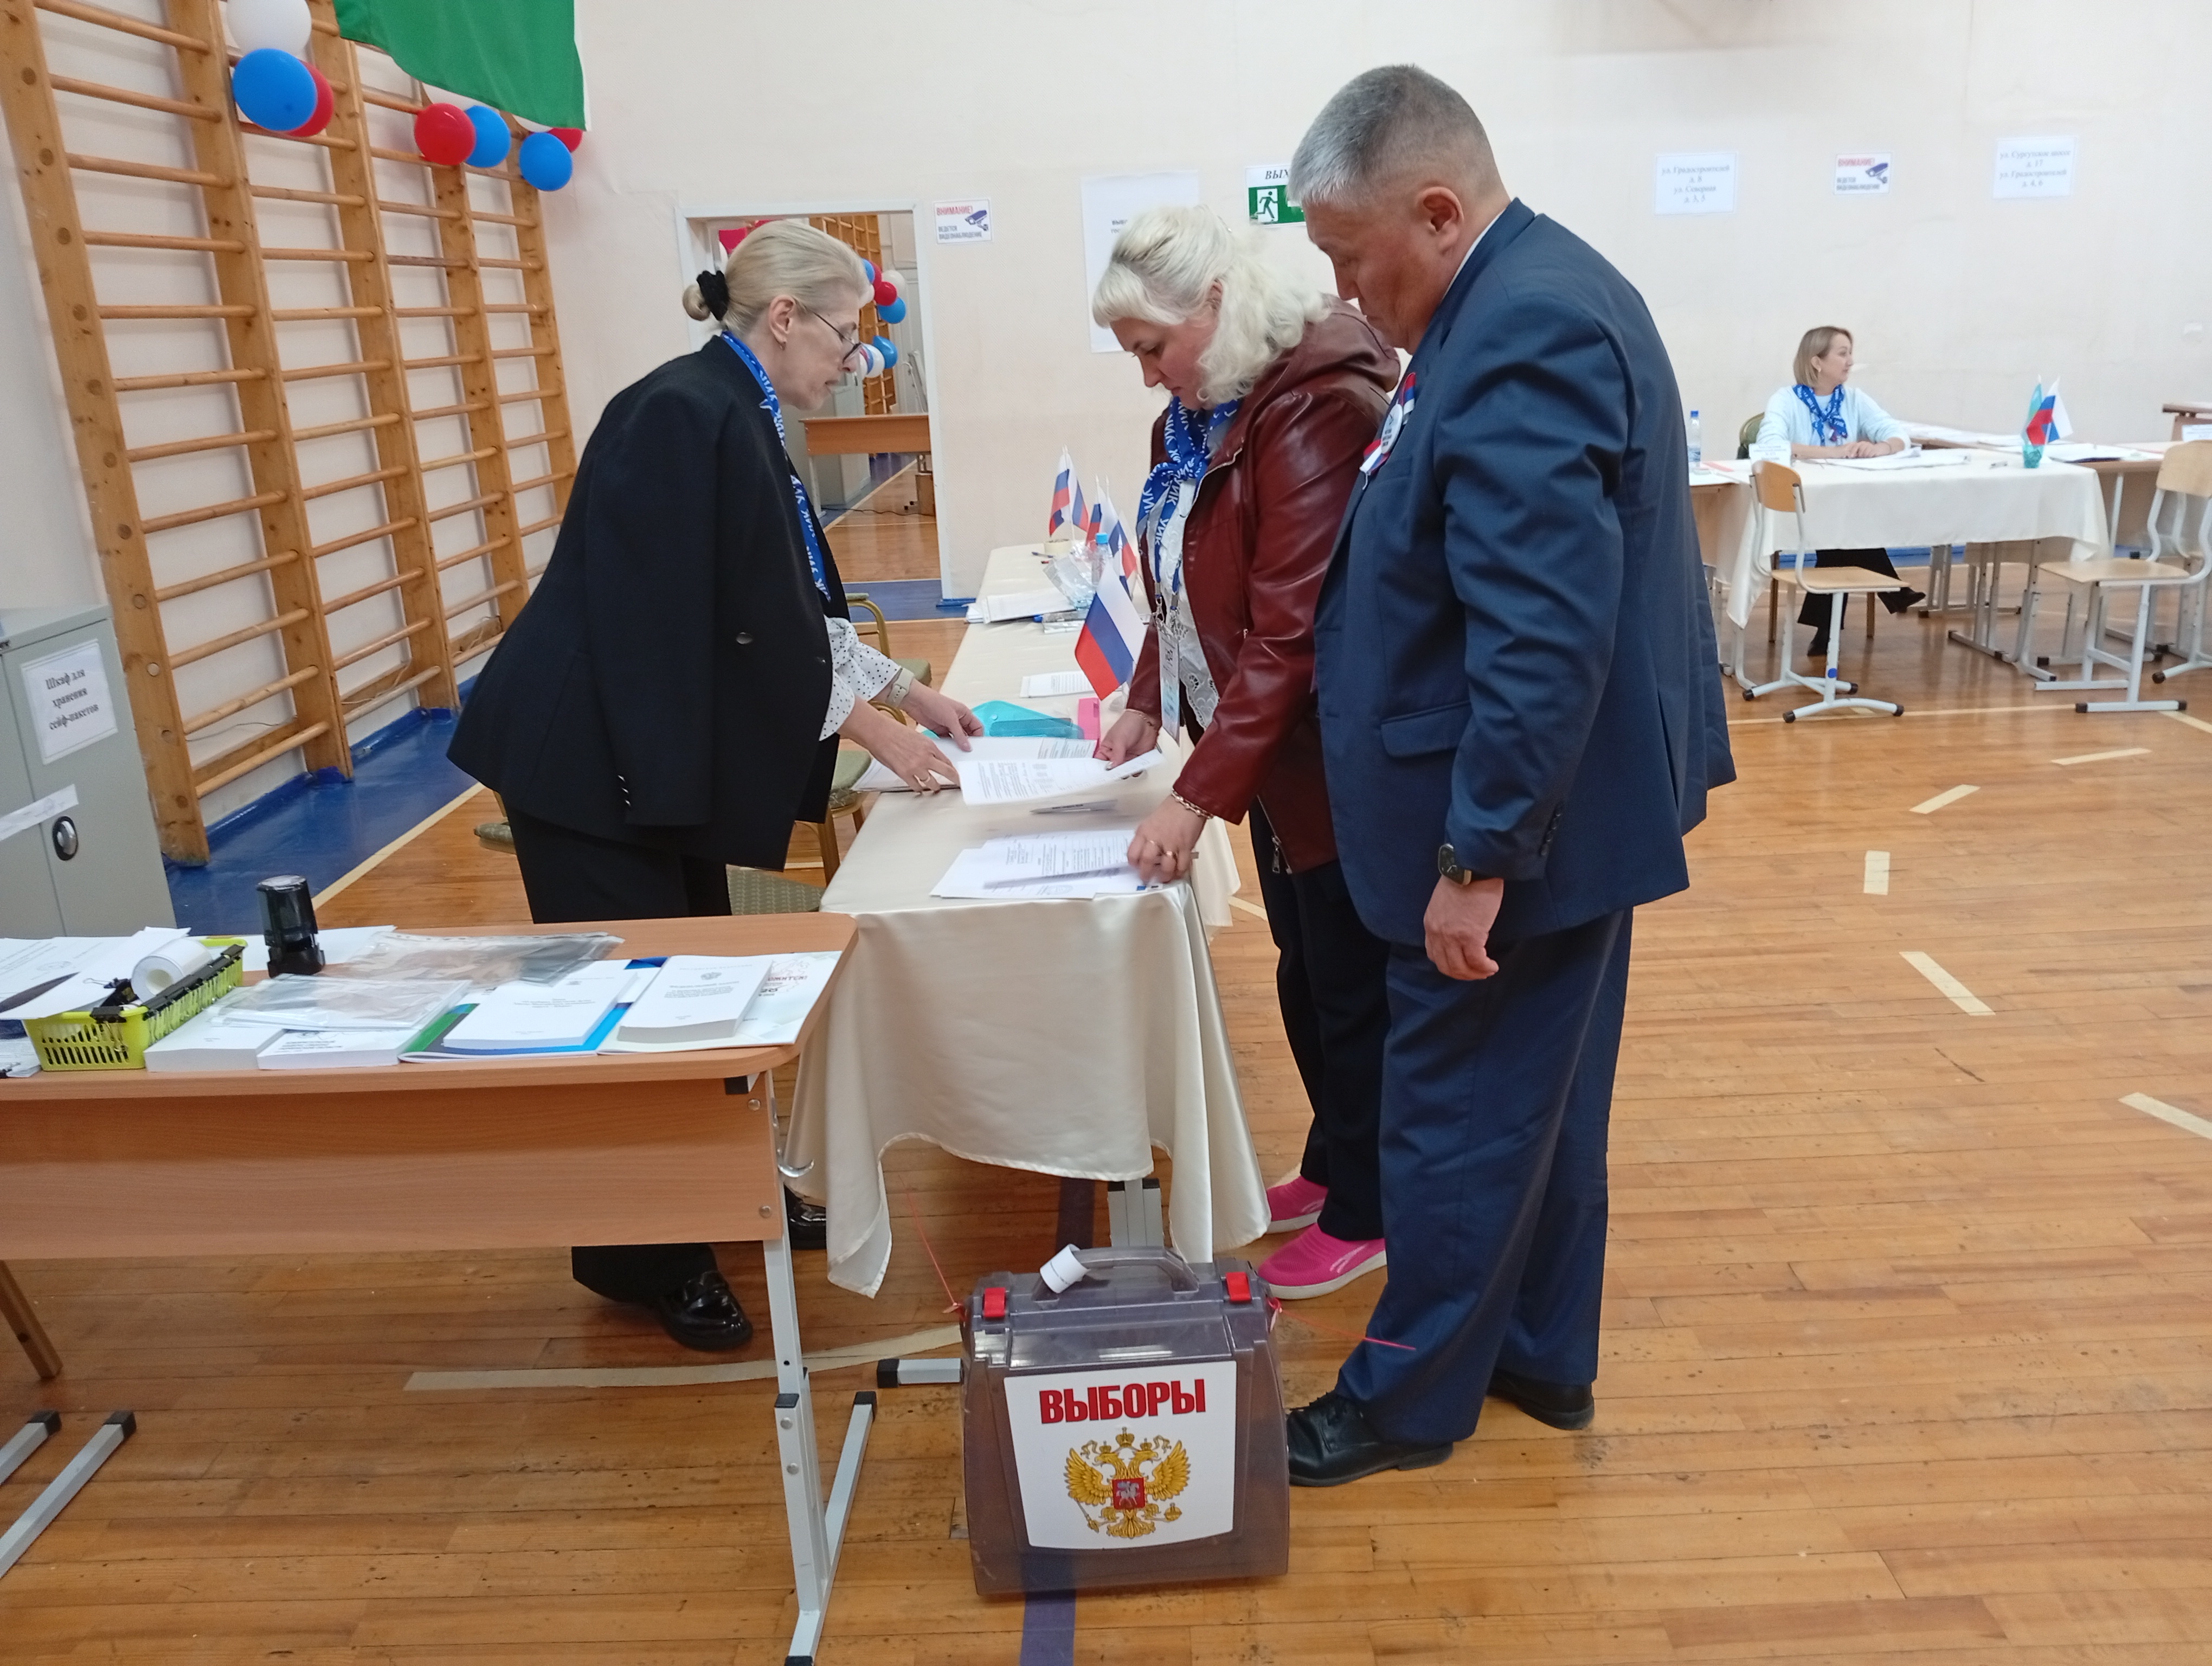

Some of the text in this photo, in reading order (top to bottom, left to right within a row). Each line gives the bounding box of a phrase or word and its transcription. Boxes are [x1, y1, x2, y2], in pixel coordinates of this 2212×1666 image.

[936, 206, 973, 216] ВНИМАНИЕ!
[1142, 488, 1155, 513] УИ
[1155, 518, 1170, 546] УИК
[45, 669, 86, 690] Шкаф для
[52, 688, 88, 709] хранения
[49, 704, 99, 730] сейф-пакетов
[1039, 1379, 1206, 1424] ВЫБОРЫ
